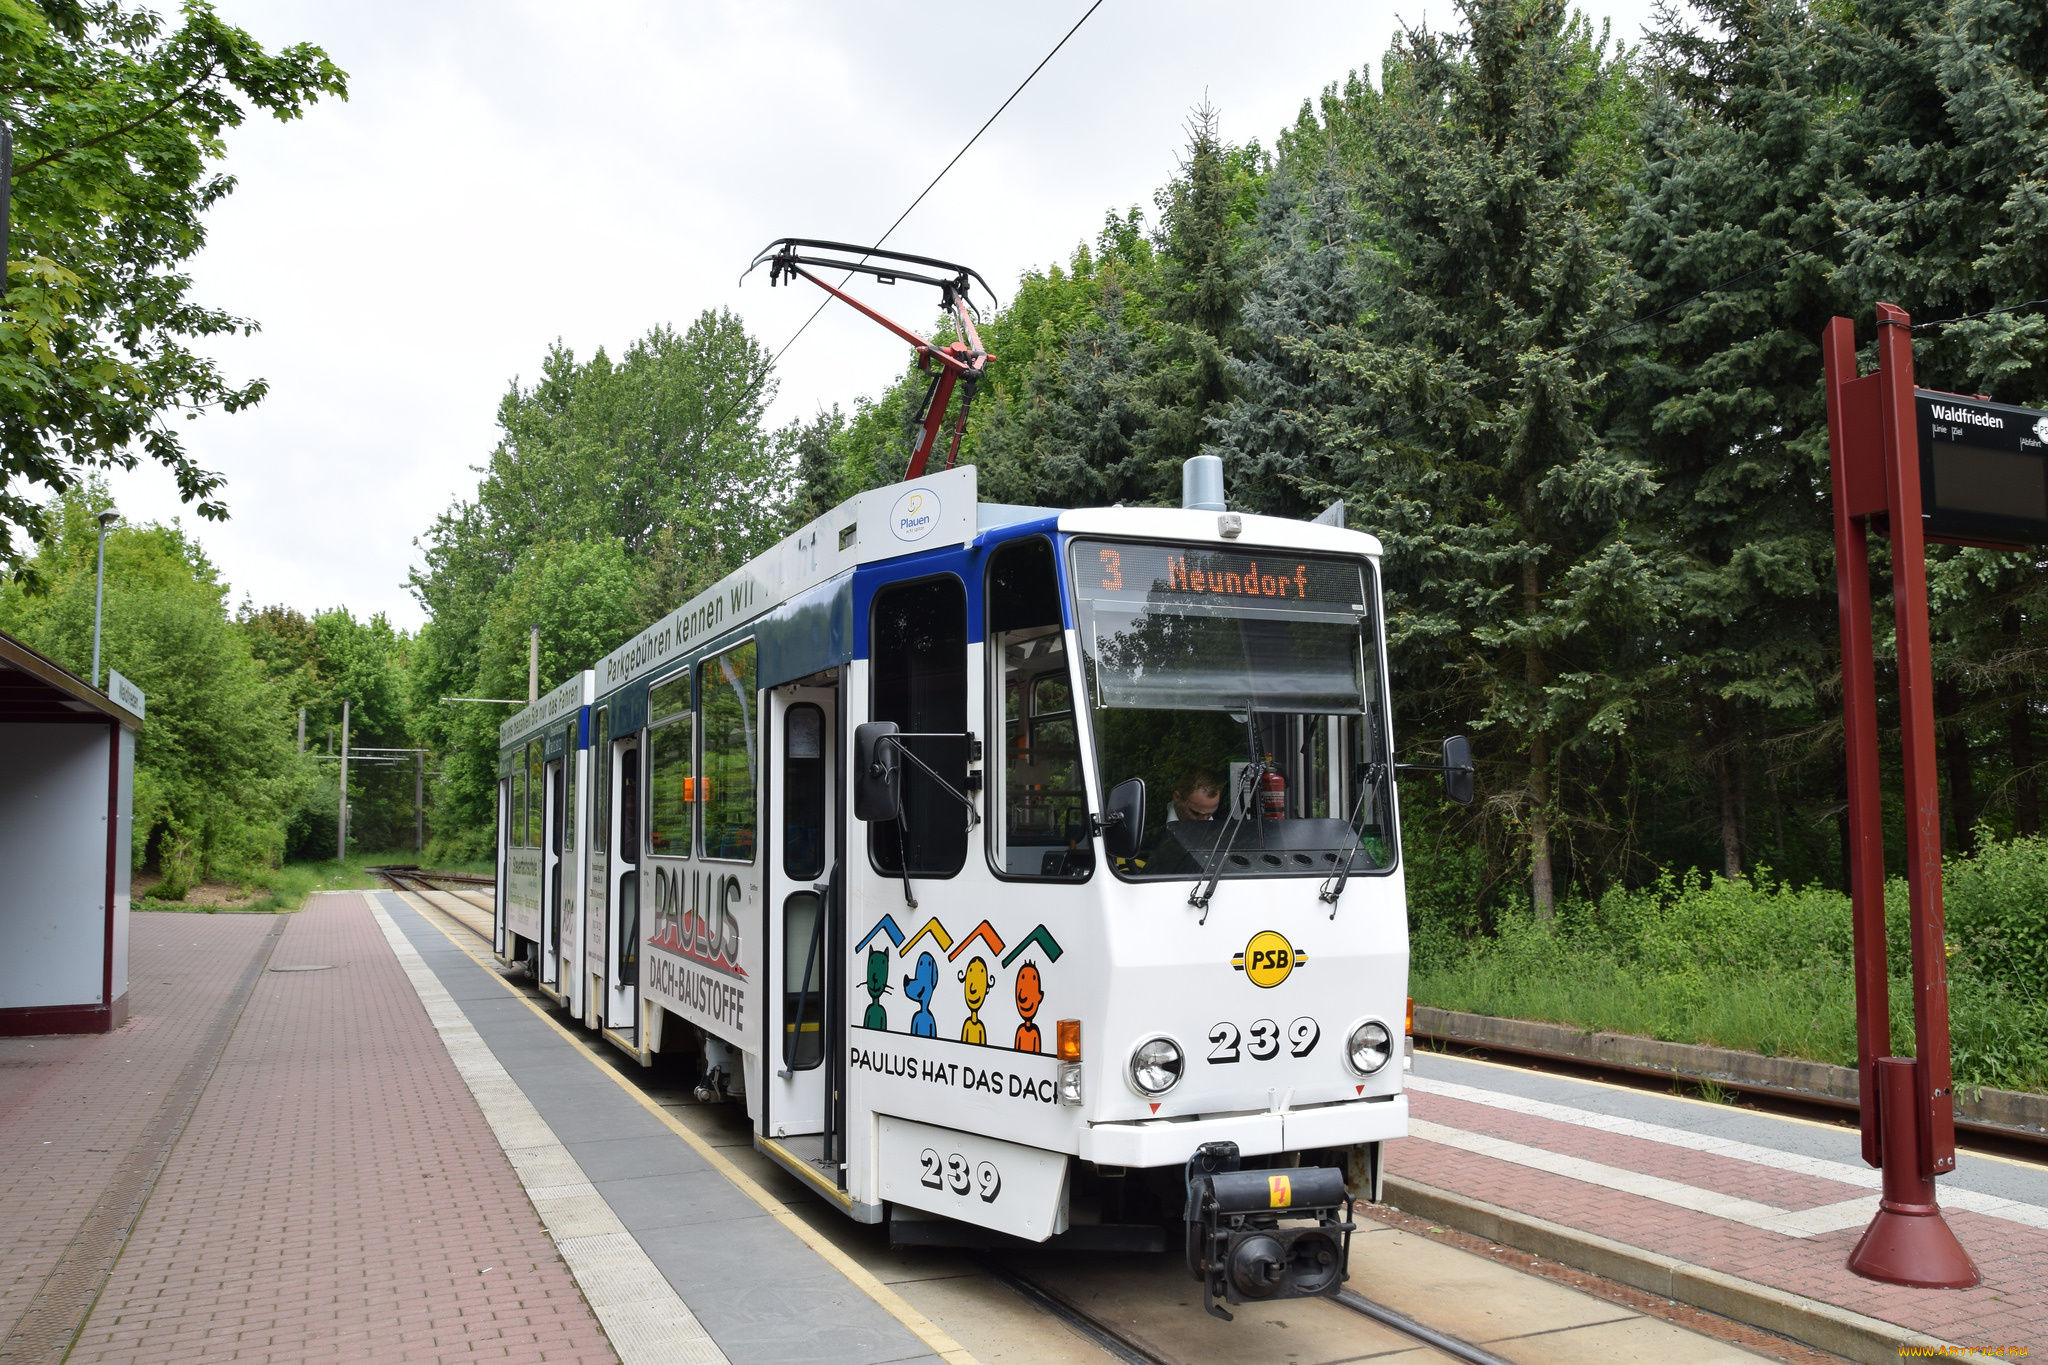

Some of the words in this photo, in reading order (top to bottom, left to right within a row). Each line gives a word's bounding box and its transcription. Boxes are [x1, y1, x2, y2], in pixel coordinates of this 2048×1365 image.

[1931, 404, 2003, 428] Waldfrieden
[1934, 424, 1947, 434] Linie
[1953, 427, 1963, 436] Ziel
[2022, 438, 2042, 448] Abfahrt
[901, 516, 930, 529] Plauen
[1100, 549, 1122, 591] 3
[1167, 555, 1308, 598] Neundorf
[606, 627, 671, 686] Parkgebühren
[675, 594, 724, 647] kennen
[730, 574, 755, 616] wir
[531, 706, 539, 726] Sie
[540, 703, 548, 720] nur
[548, 696, 557, 717] das
[559, 684, 578, 710] Fahren
[655, 865, 742, 967] PAULUS
[1251, 949, 1289, 970] PSB
[650, 954, 745, 1032] DACH-BAUSTOFFE
[1206, 1016, 1321, 1065] 239
[851, 1047, 918, 1079] PAULUS
[922, 1060, 958, 1086] HAT
[963, 1066, 1004, 1094] DAS
[920, 1147, 1002, 1204] 239
